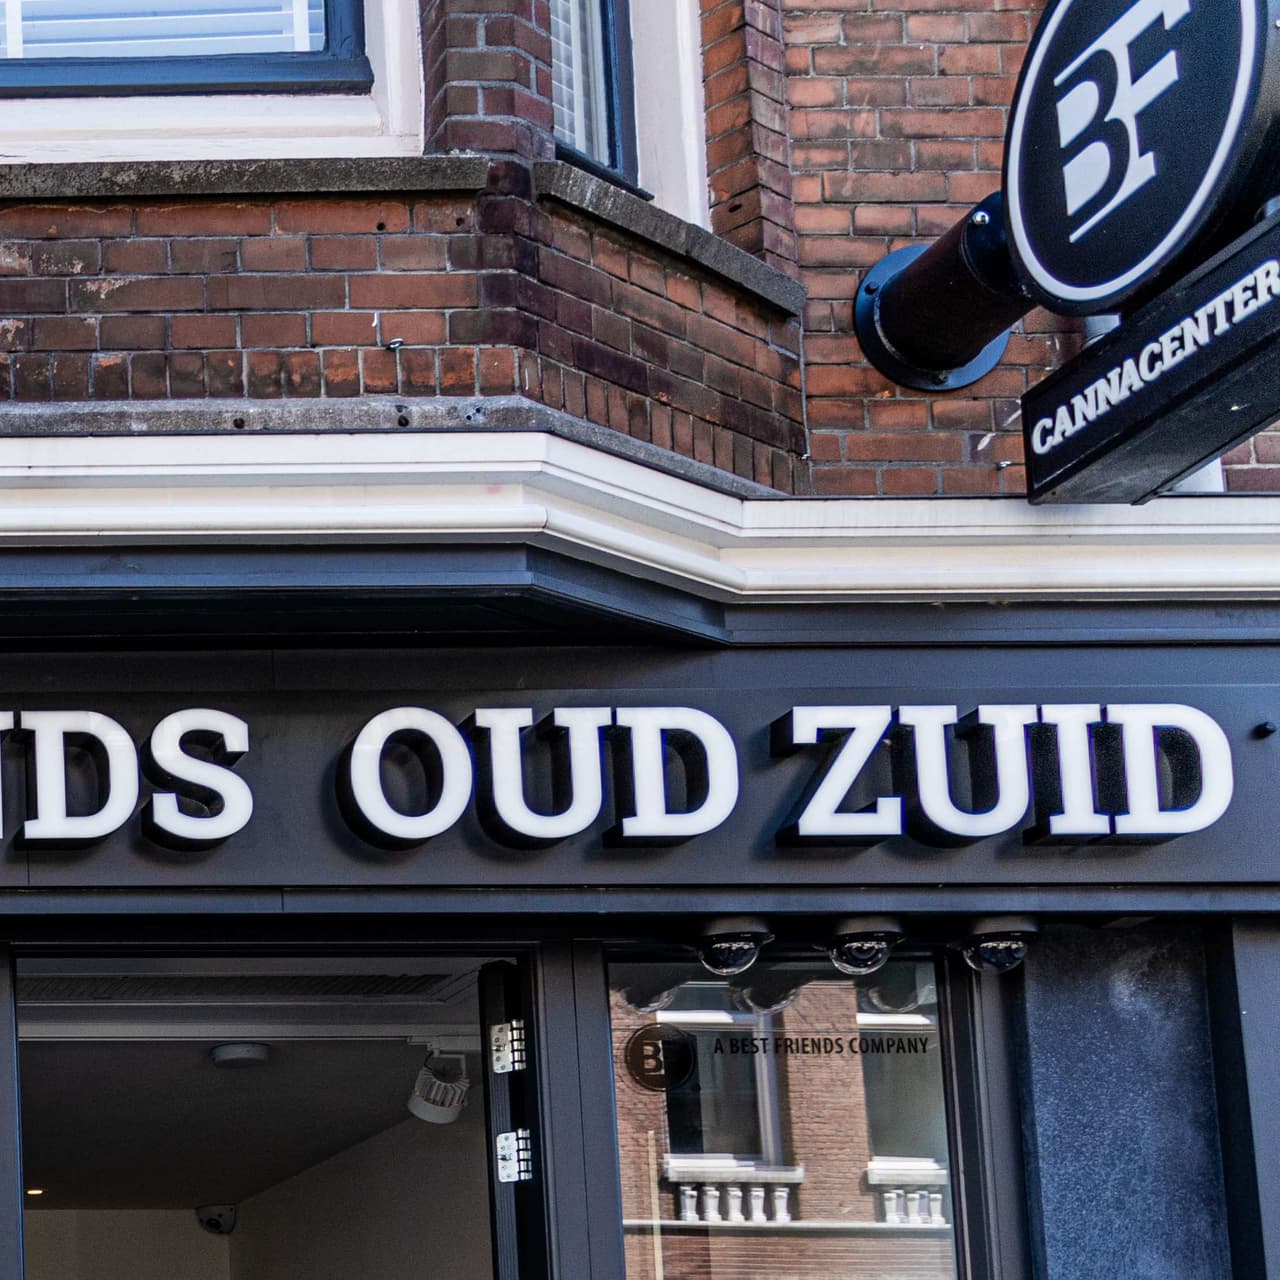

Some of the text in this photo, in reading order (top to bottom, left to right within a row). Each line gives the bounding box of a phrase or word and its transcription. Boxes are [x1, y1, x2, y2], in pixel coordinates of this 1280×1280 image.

[1031, 258, 1280, 456] CANNACENTER
[350, 706, 739, 840] OUD
[792, 702, 1235, 838] ZUID
[714, 1037, 929, 1054] A BEST FRIENDS COMPANY
